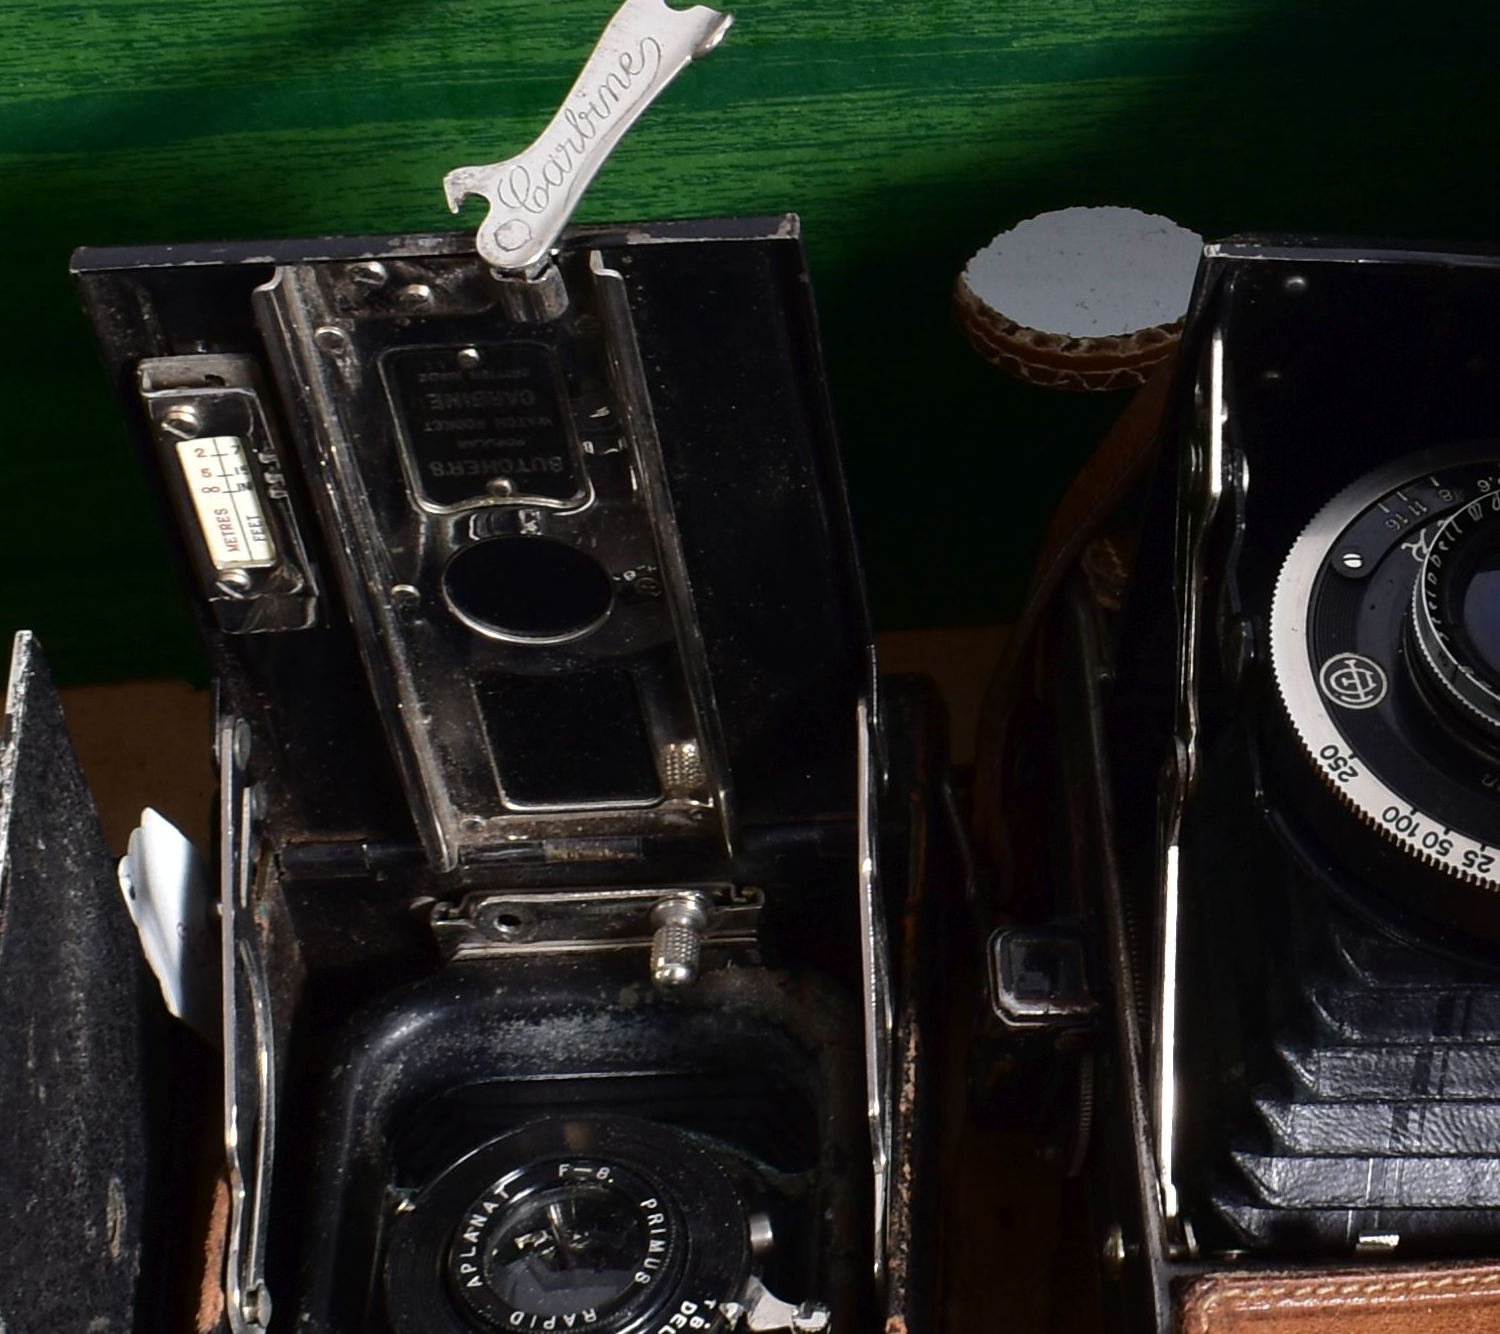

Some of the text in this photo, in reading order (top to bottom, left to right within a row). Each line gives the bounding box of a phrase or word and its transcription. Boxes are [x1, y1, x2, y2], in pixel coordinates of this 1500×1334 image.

[498, 37, 662, 214] Carbine
[425, 388, 536, 410] CARBINE
[201, 468, 212, 478] 5
[213, 508, 241, 553] METRES
[1320, 744, 1359, 784] 250
[1382, 805, 1419, 839] 100
[1422, 830, 1454, 858] 50
[1463, 849, 1495, 875] 25
[460, 1182, 511, 1289] APLANAT
[640, 1197, 668, 1286] PRIMUS
[508, 1307, 598, 1331] RAPID
[689, 1315, 706, 1331] B
